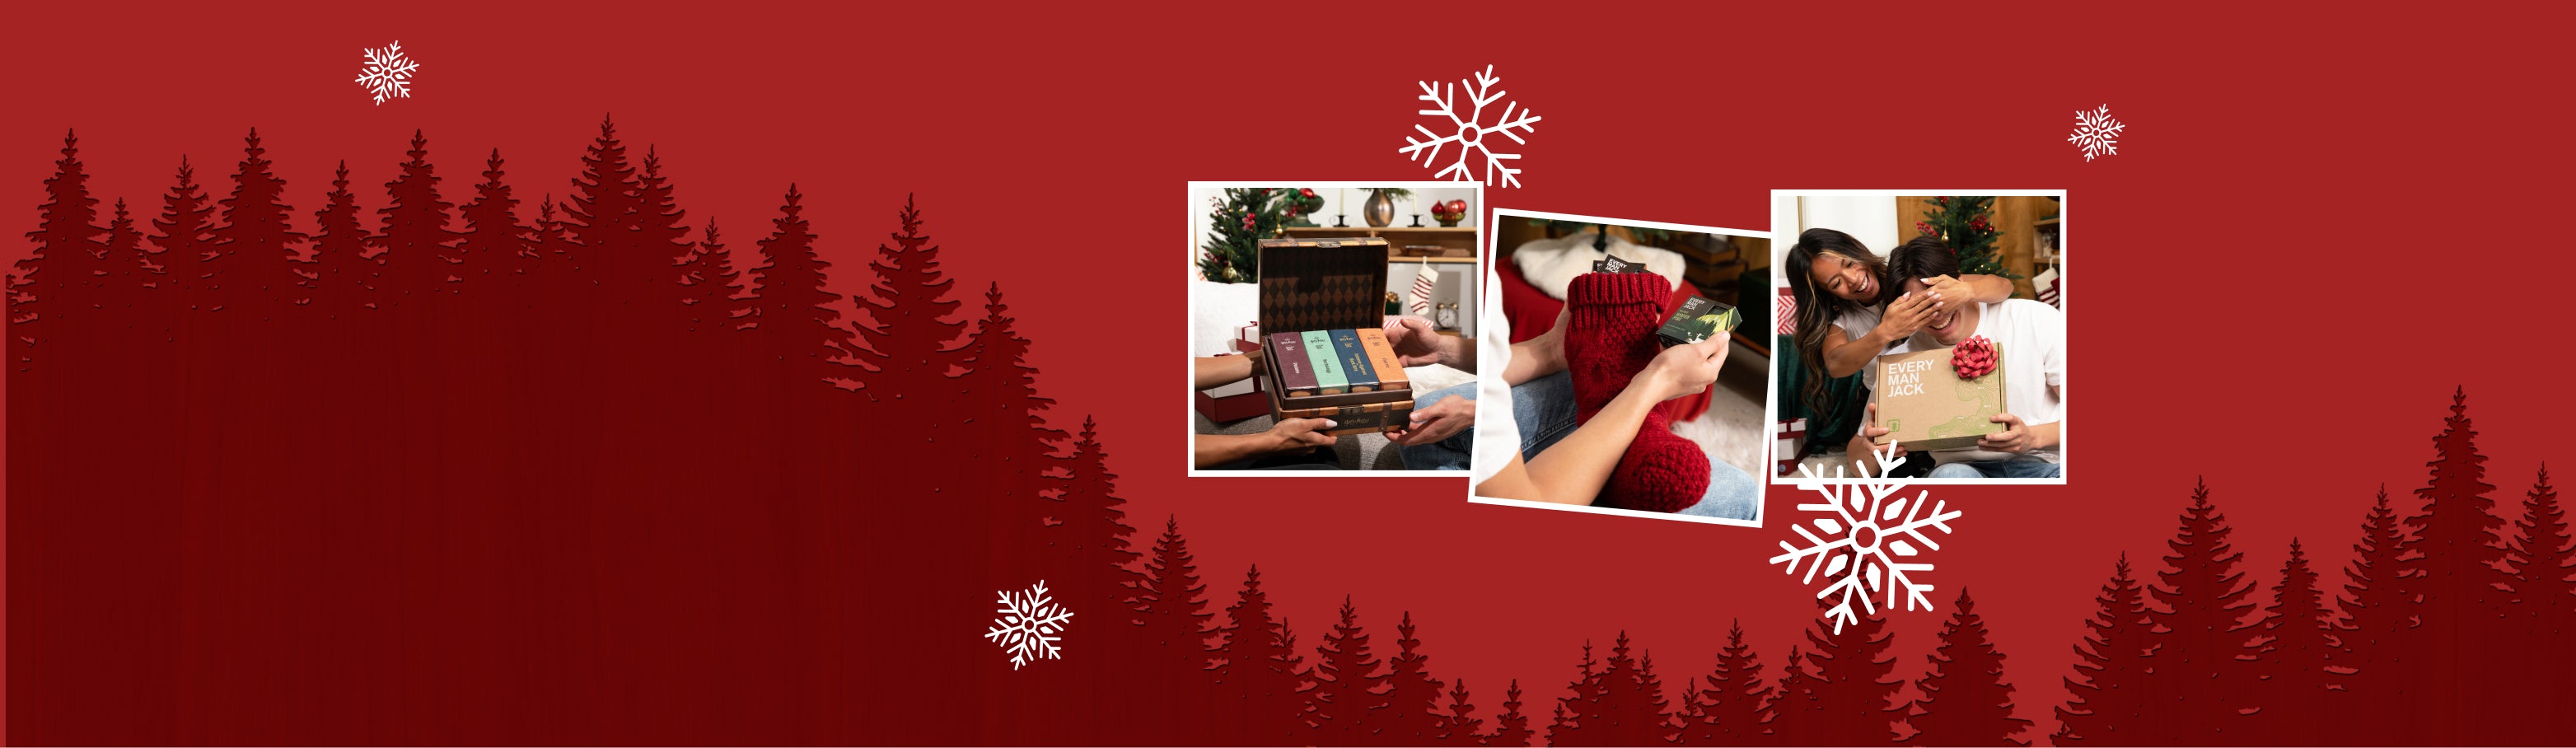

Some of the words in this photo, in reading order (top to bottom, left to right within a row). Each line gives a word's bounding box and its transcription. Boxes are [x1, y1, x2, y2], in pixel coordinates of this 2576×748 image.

[1609, 258, 1627, 269] EVERY
[1888, 359, 1934, 375] EVERY
[1888, 372, 1919, 386] MAN
[1887, 382, 1924, 398] JACK
